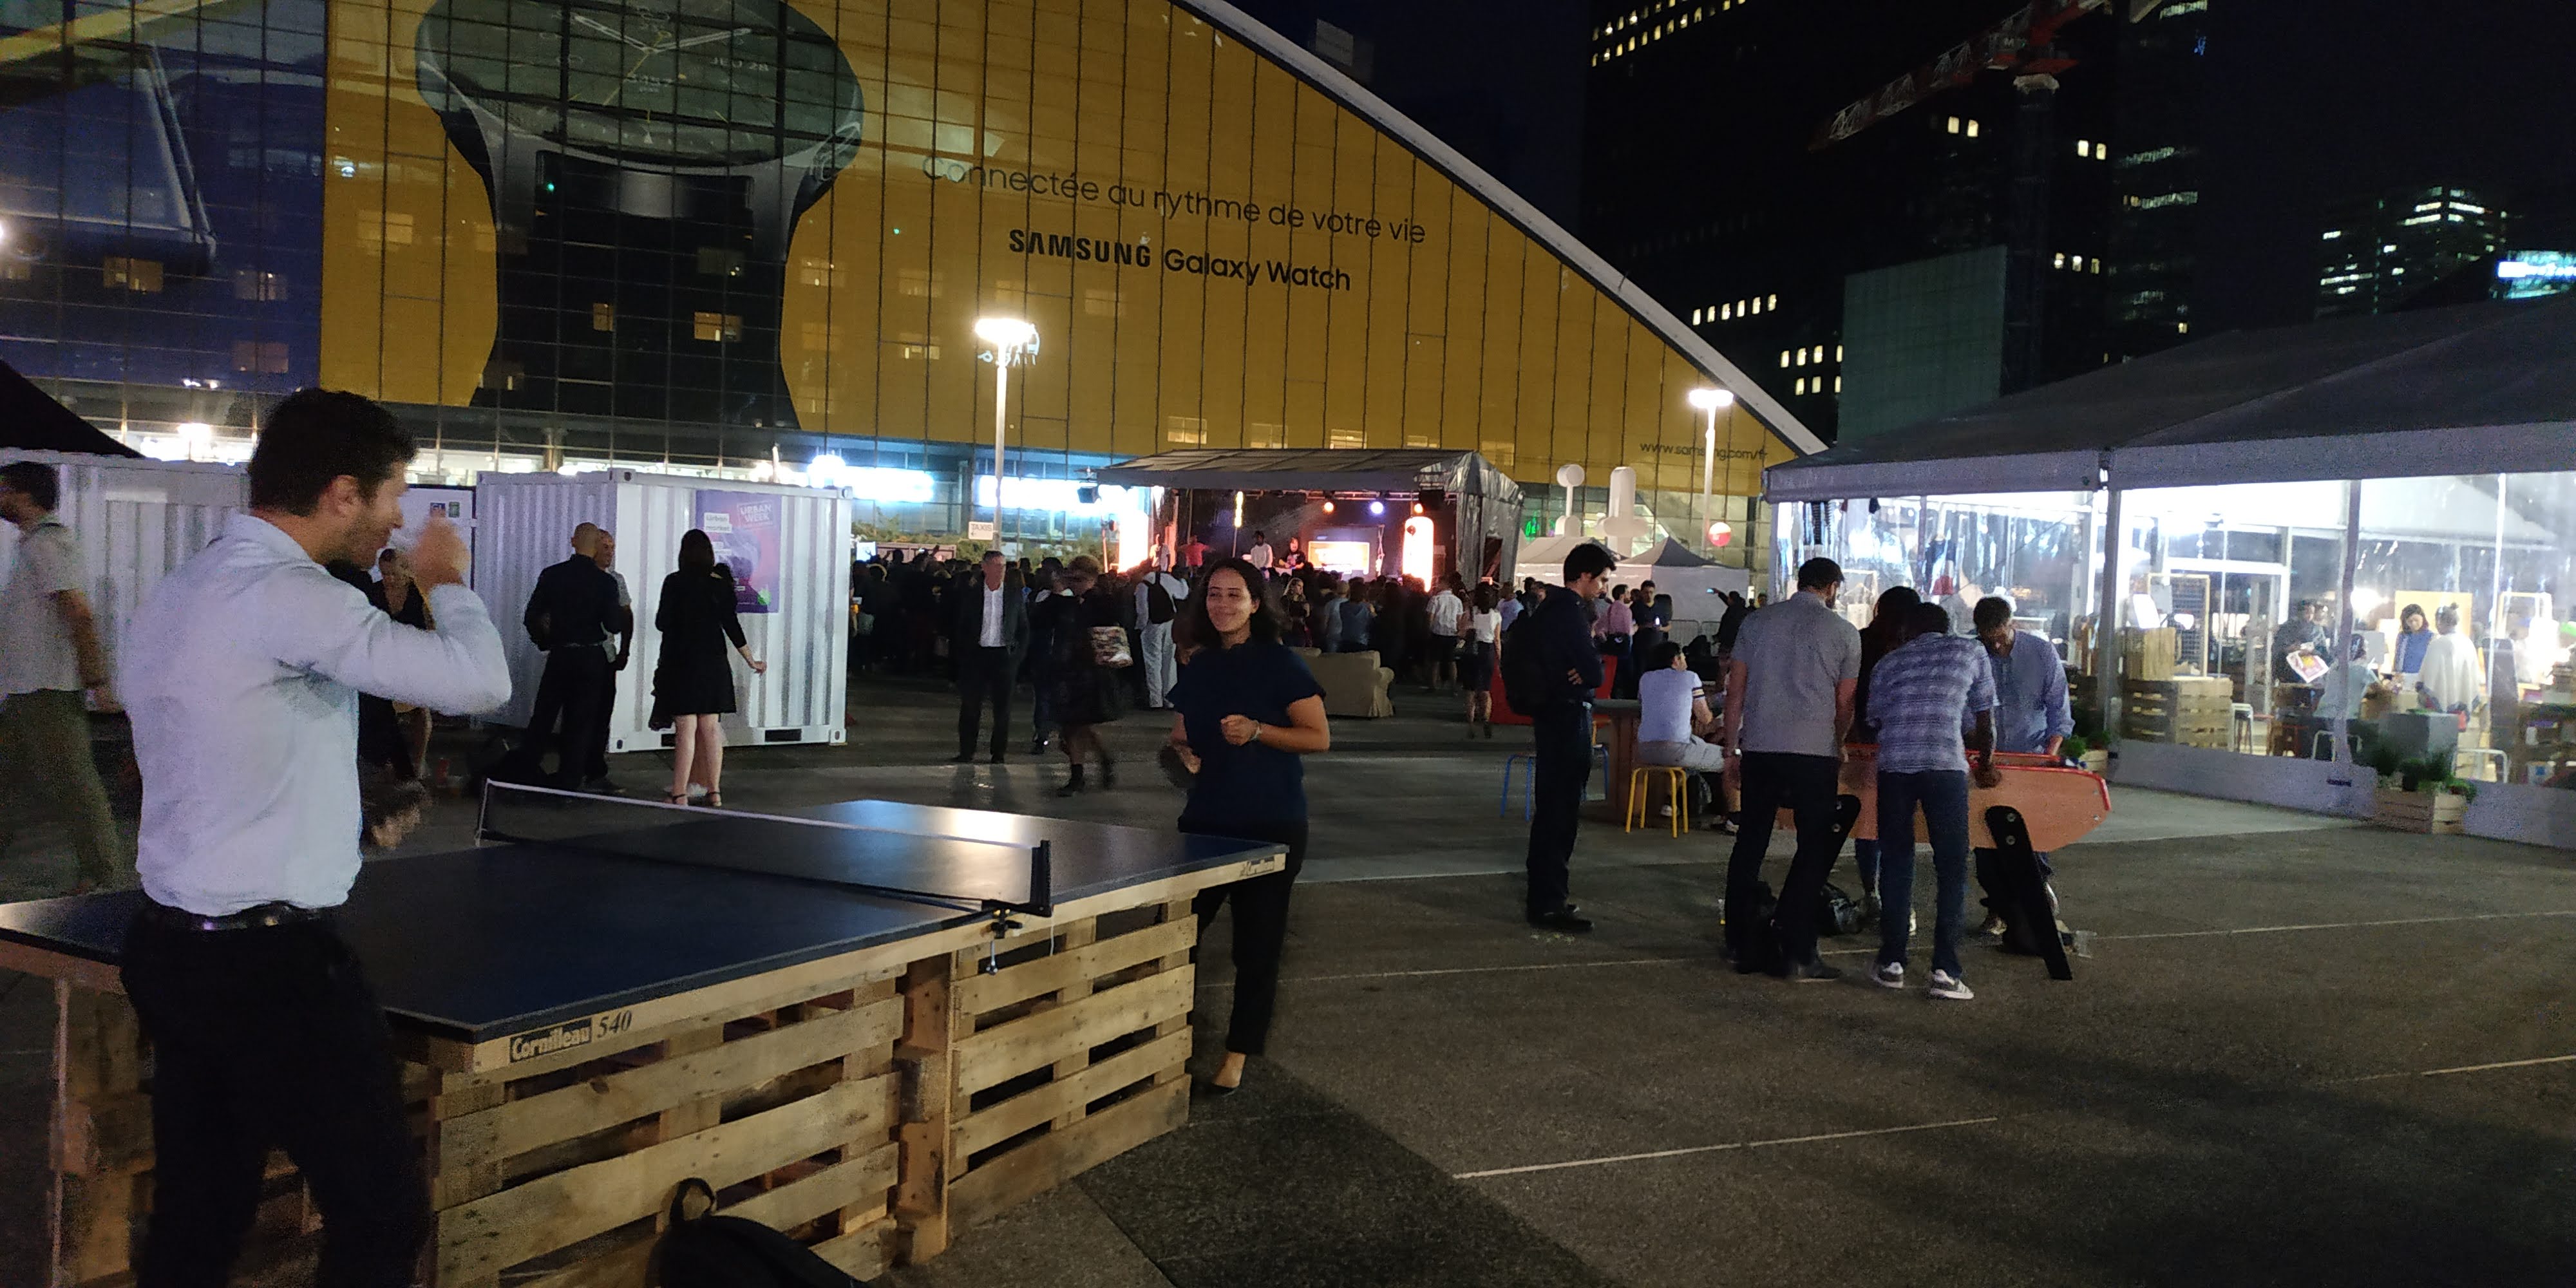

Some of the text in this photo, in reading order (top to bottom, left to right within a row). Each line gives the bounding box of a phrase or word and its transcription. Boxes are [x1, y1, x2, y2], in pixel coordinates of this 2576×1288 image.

[922, 156, 1426, 243] Connectée au rythme de votre vie
[1009, 229, 1351, 291] SAMSUNG Galaxy Watch
[513, 1010, 632, 1061] Cornilleau 540
